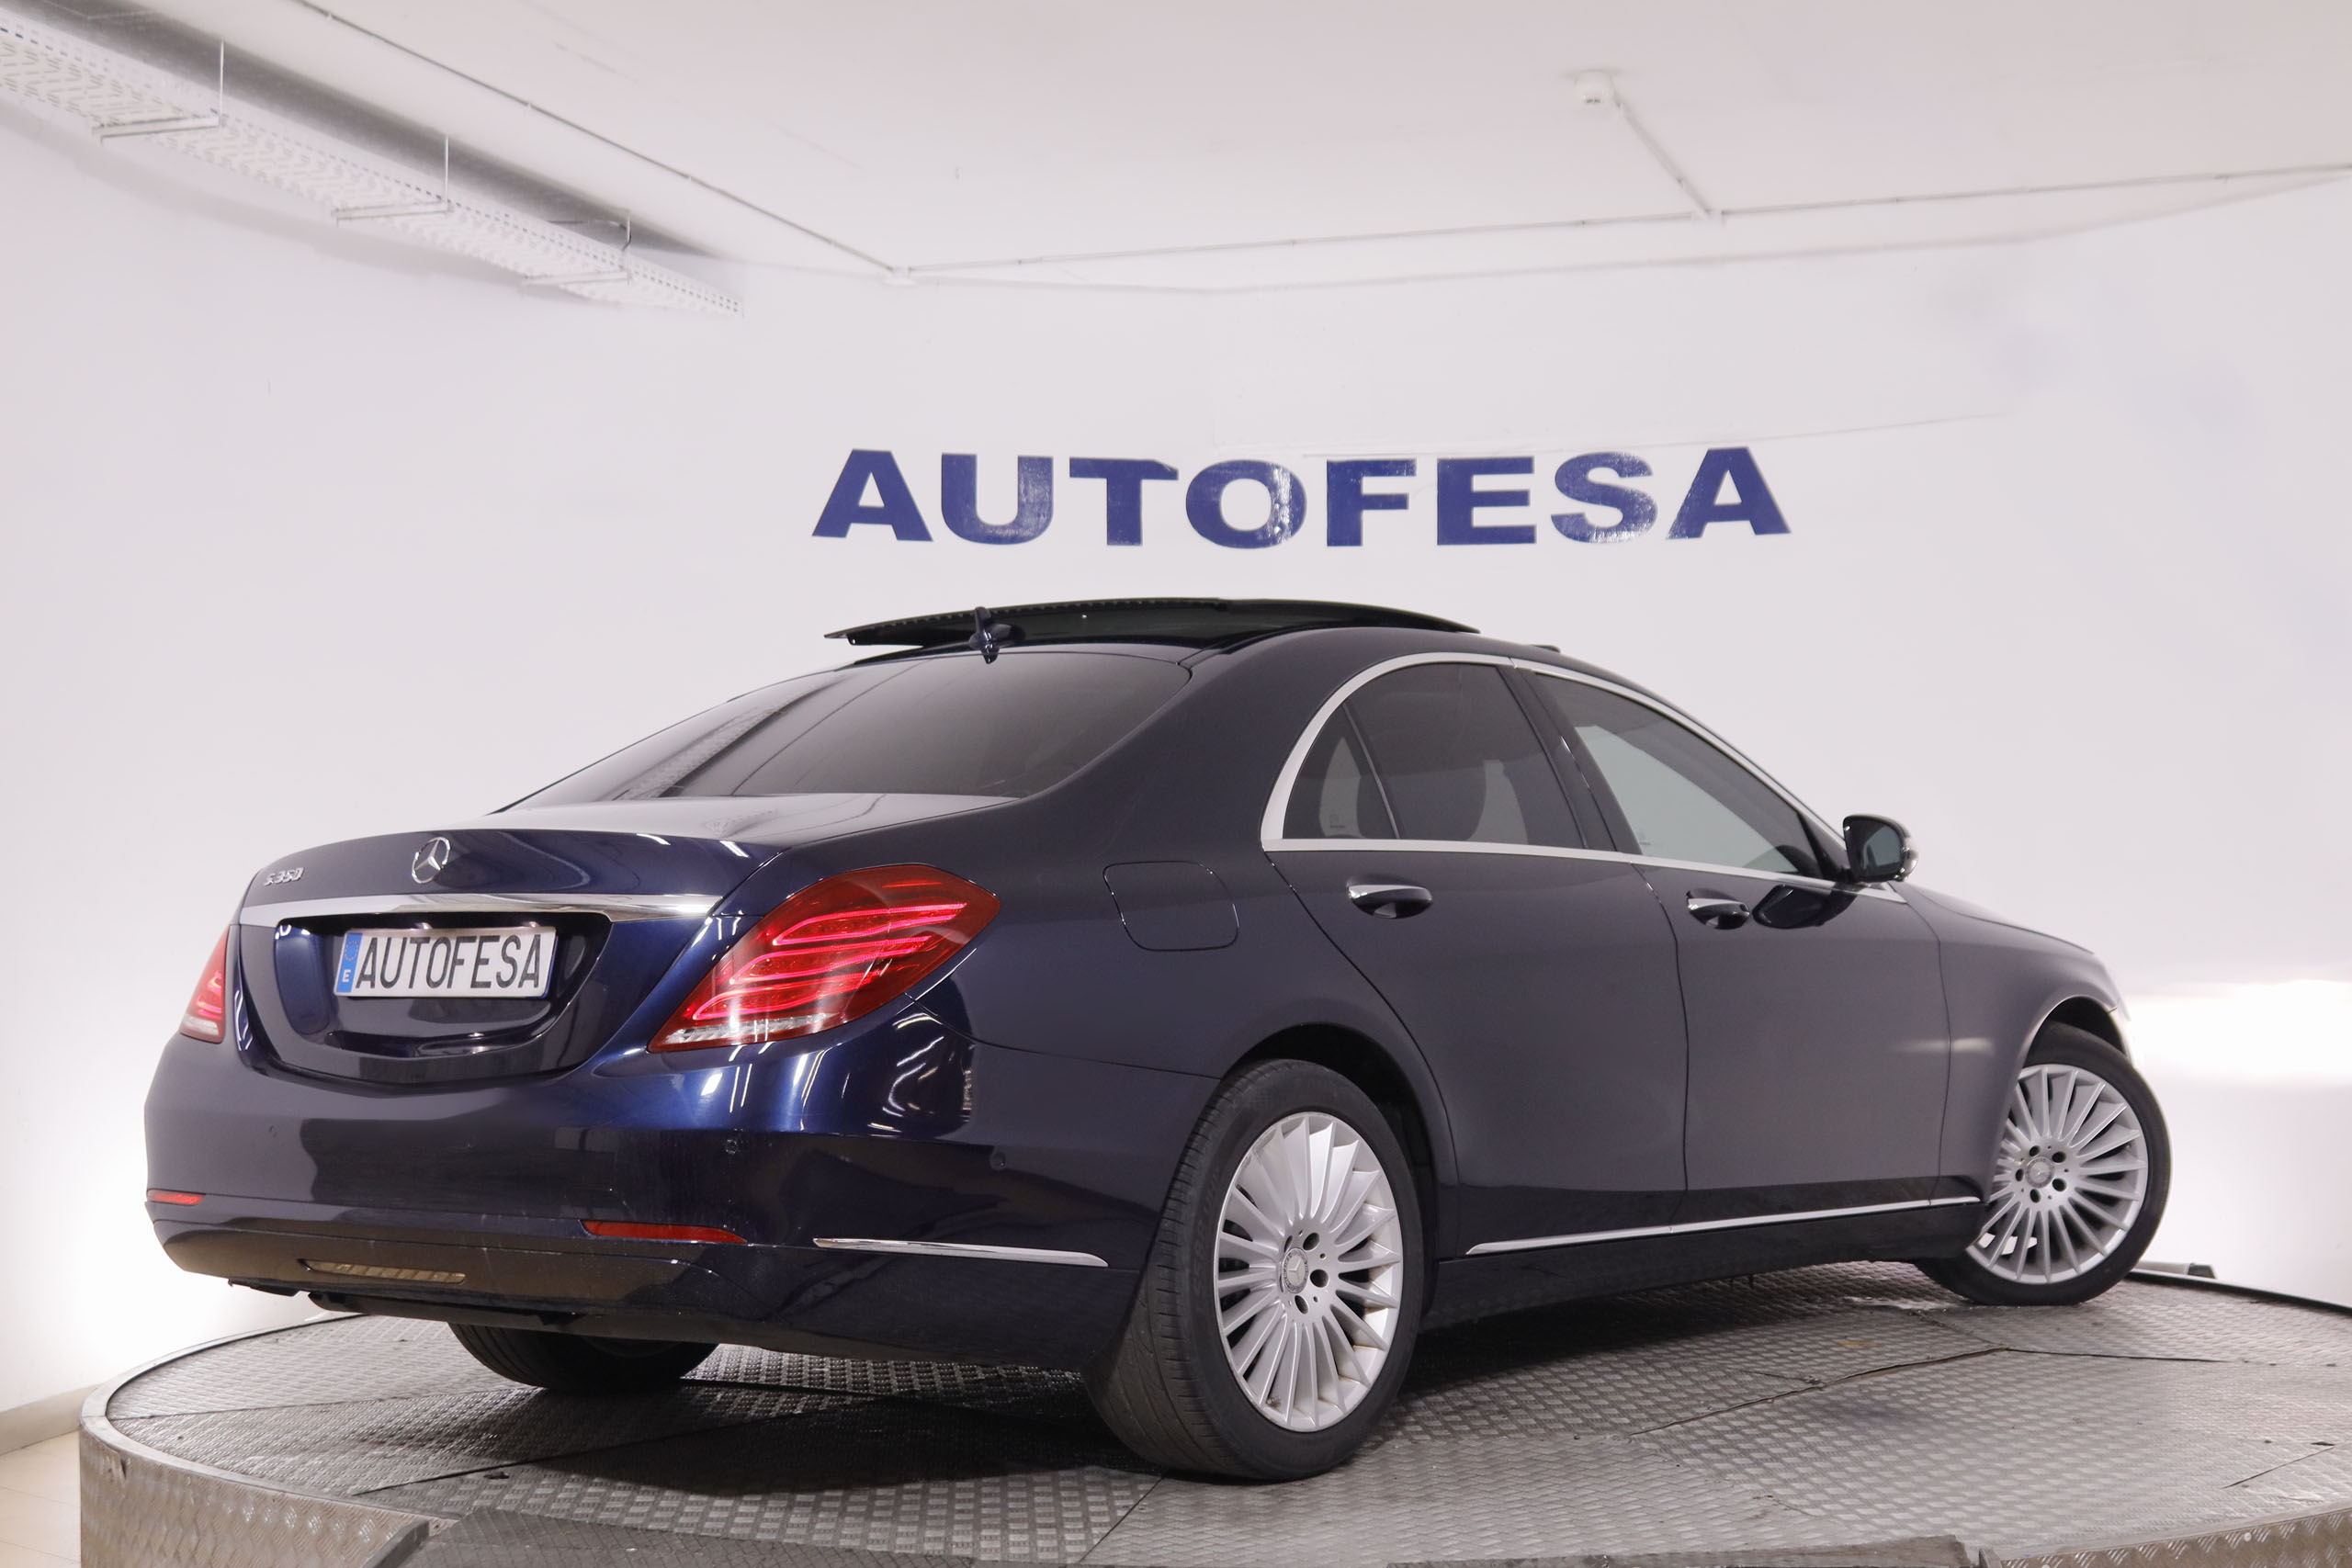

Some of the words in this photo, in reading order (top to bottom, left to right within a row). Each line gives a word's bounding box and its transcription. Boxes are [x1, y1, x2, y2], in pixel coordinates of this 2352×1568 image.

[812, 447, 1790, 549] AUTOFESA
[342, 969, 351, 982] E
[355, 933, 542, 989] AUTOFESA
